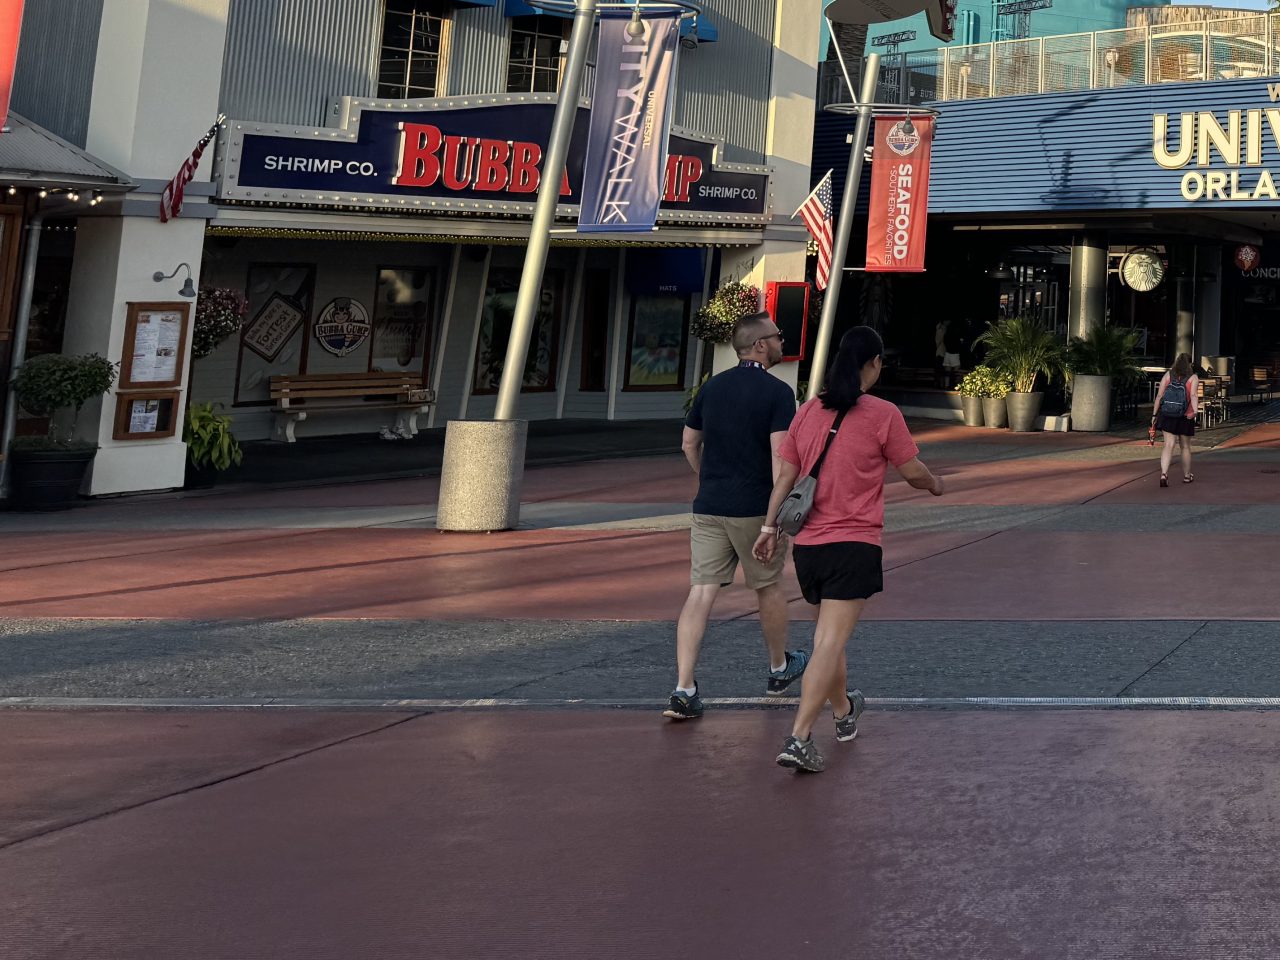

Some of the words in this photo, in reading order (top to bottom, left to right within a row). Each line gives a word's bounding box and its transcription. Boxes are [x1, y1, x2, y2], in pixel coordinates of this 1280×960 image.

[603, 19, 651, 223] CITYWALK
[642, 90, 656, 148] UNIVERSAL
[264, 156, 343, 174] SHRIMP
[346, 161, 378, 176] CO.
[698, 186, 740, 199] SHRIMP
[741, 188, 758, 200] CO.
[887, 169, 897, 215] SOUTHERN
[893, 163, 912, 260] SEAFOOD
[884, 217, 895, 265] FAVORITES
[255, 307, 291, 348] Forrest
[318, 324, 344, 336] BUBBA
[346, 323, 370, 335] GUMP
